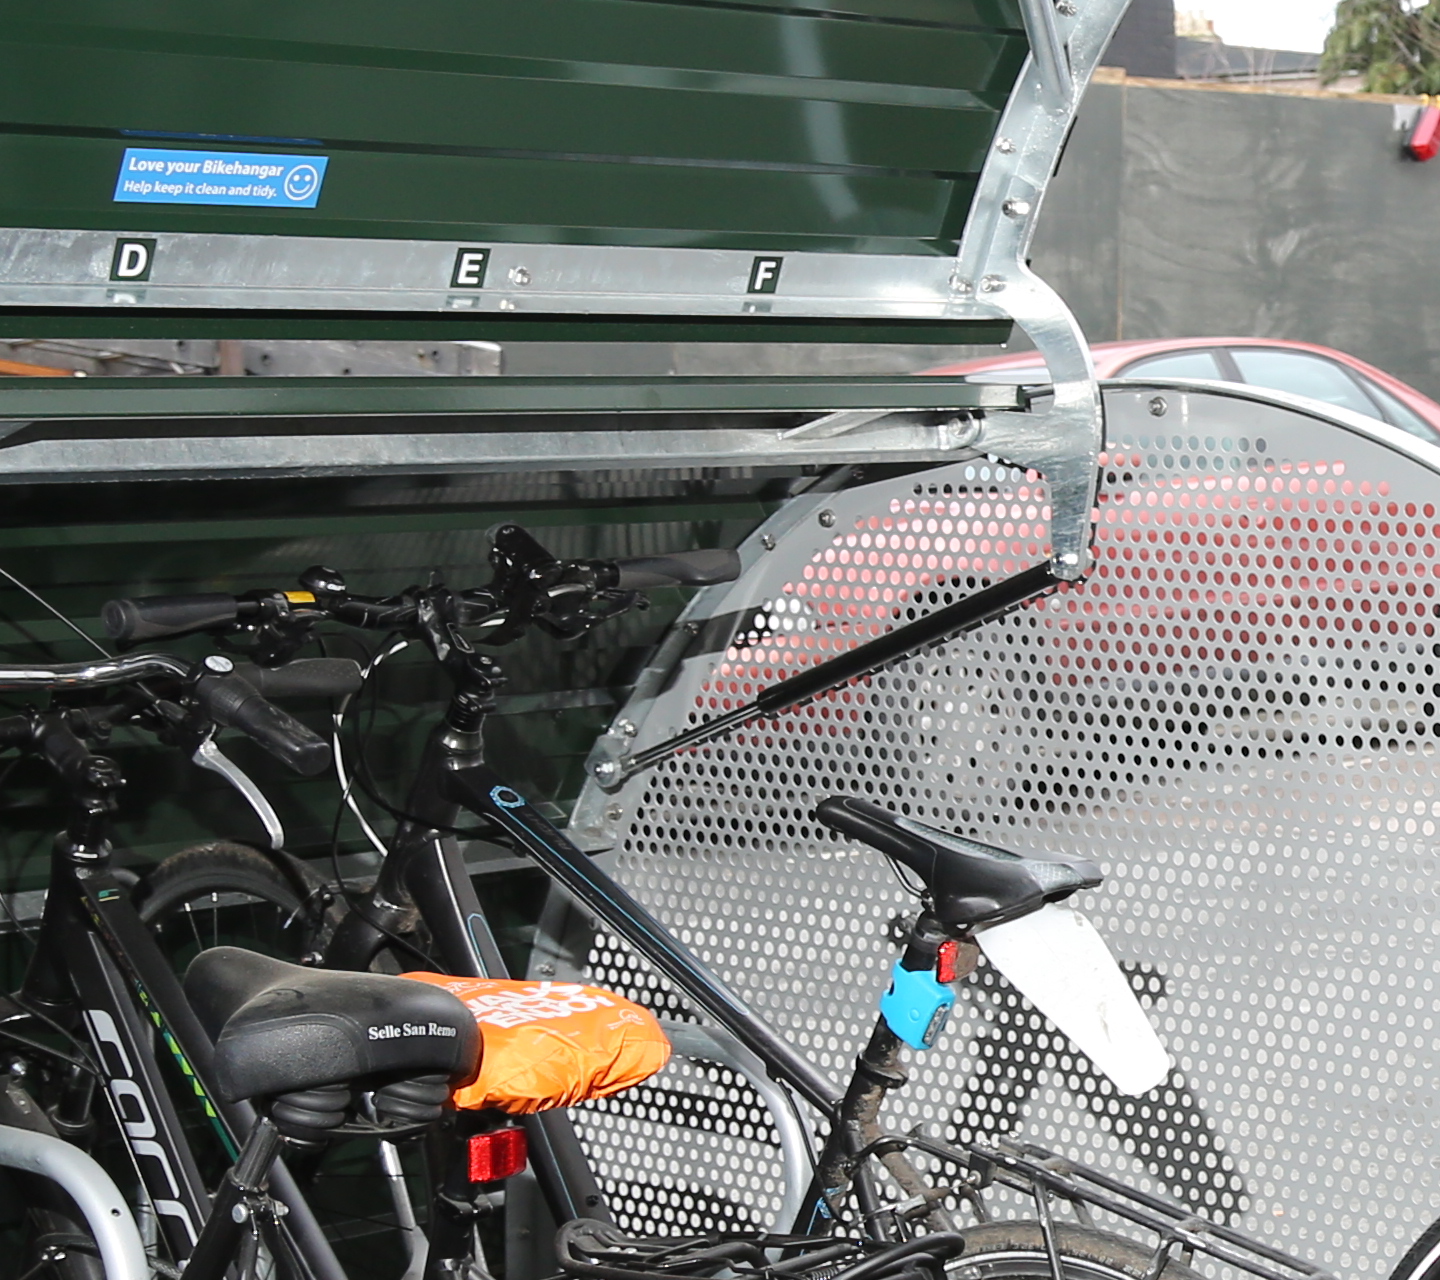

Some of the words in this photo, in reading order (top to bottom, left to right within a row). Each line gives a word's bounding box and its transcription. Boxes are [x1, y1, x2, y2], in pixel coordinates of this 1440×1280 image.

[129, 157, 164, 171] Love
[165, 161, 201, 175] your
[202, 160, 284, 179] Bikehangar
[124, 180, 152, 195] Help
[154, 181, 182, 196] keep
[184, 182, 194, 195] it
[196, 182, 225, 195] clean
[227, 184, 251, 196] and
[252, 185, 278, 199] tidy.
[118, 244, 146, 276] D
[458, 254, 483, 284] E
[755, 262, 776, 289] F
[368, 1025, 401, 1040] Selle
[402, 1022, 426, 1037] San
[428, 1022, 456, 1037] Remo
[83, 1009, 200, 1261] carr
